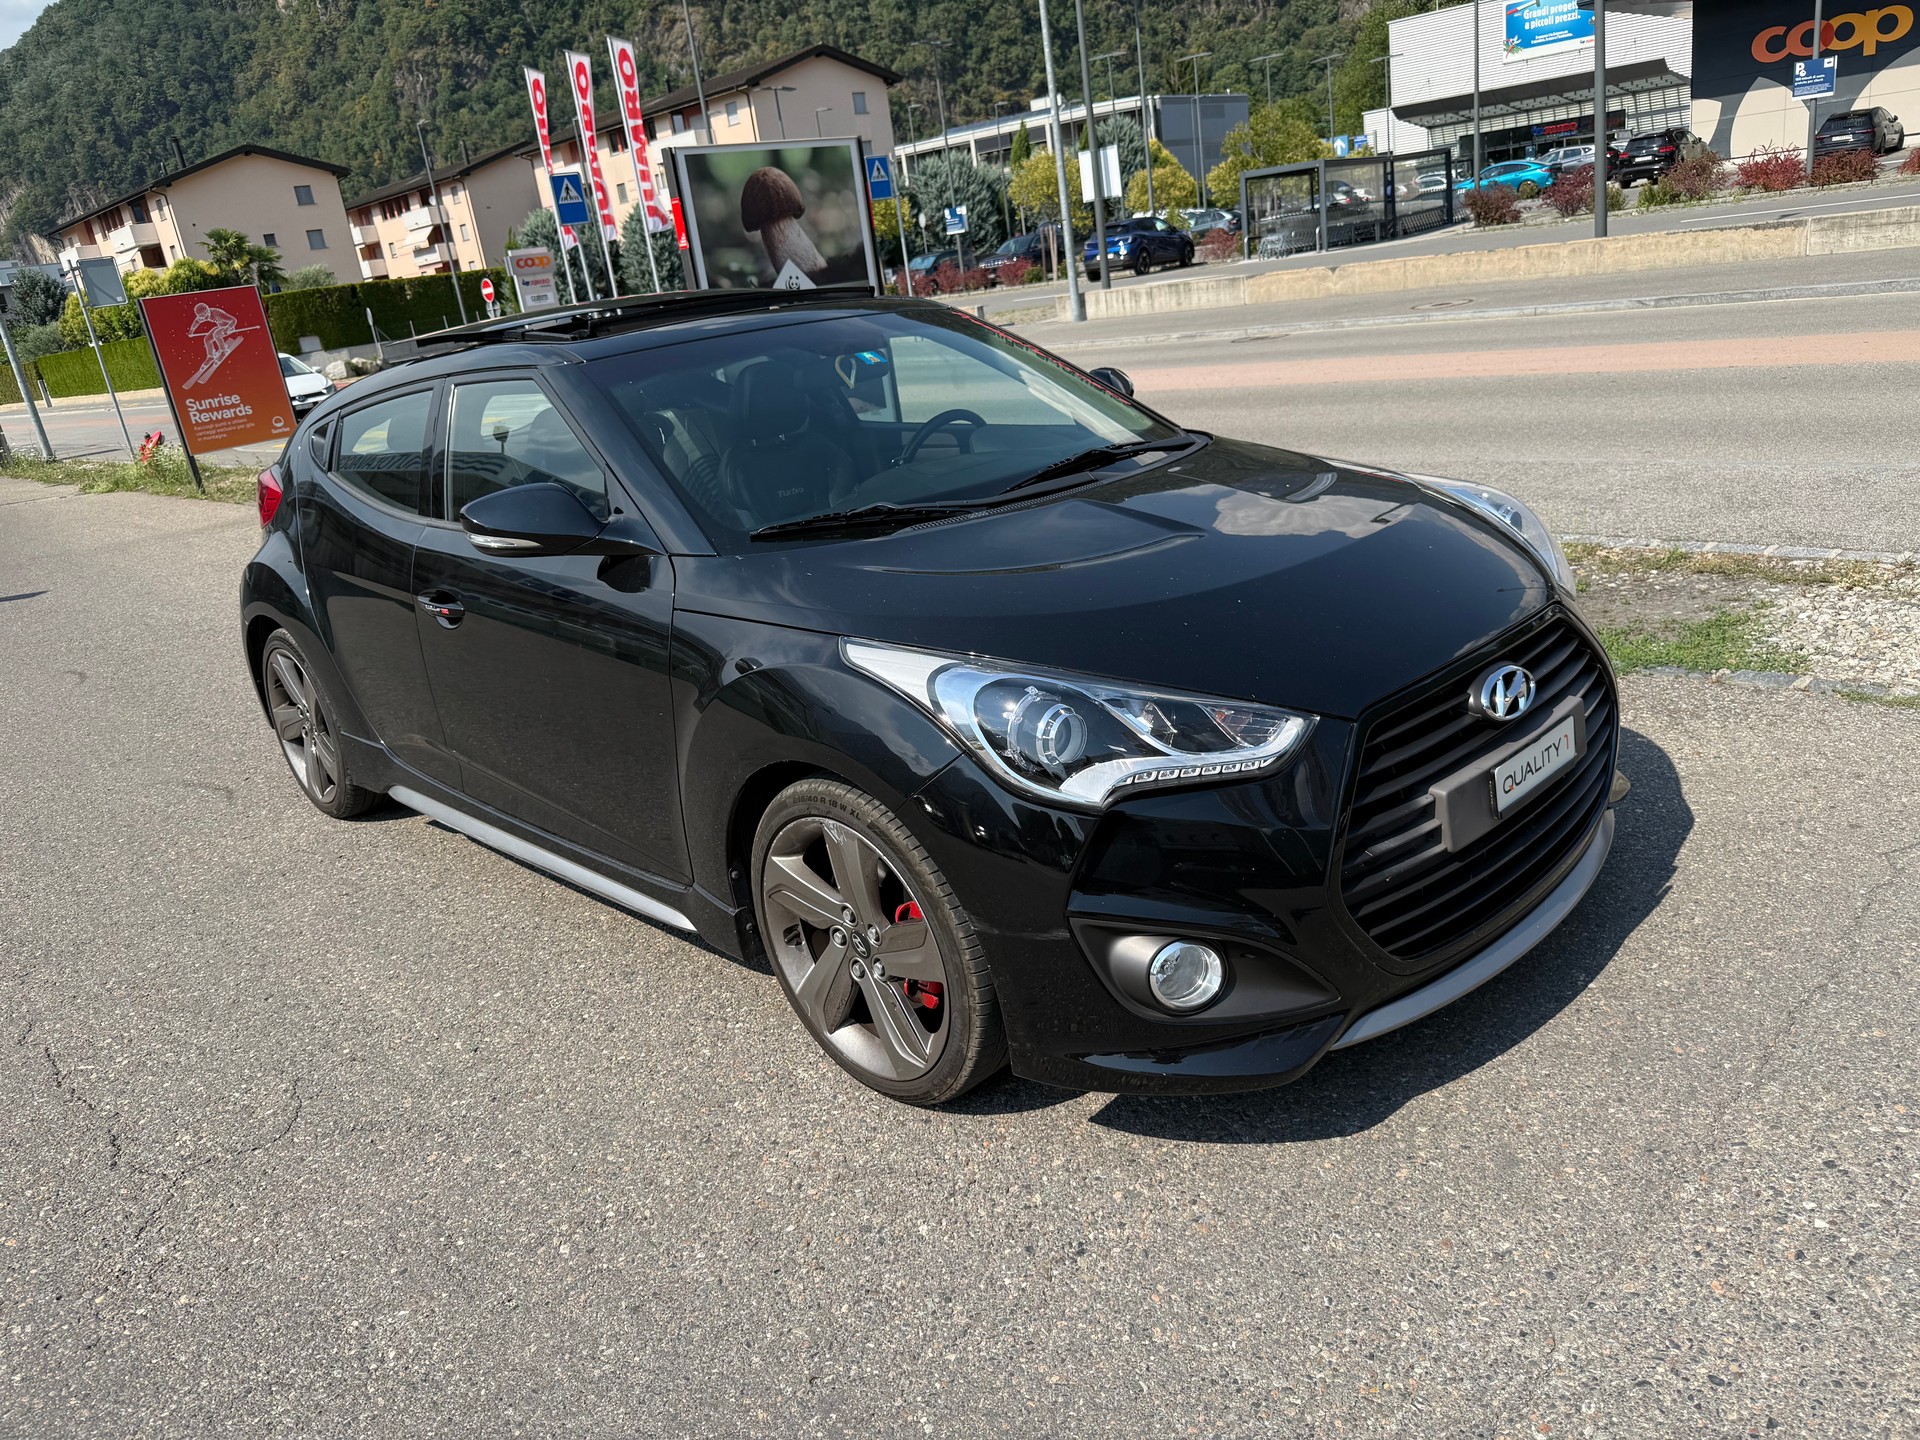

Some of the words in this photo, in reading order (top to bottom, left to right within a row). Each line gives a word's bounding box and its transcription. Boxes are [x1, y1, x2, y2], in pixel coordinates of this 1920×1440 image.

[1523, 5, 1549, 20] Grandi
[1550, 0, 1579, 15] progett
[1524, 21, 1530, 30] a
[1530, 15, 1554, 30] piccoli
[1555, 10, 1581, 25] prezzi.
[1751, 5, 1914, 63] coop
[575, 61, 618, 234] JUMBO
[618, 48, 669, 226] JUMBO
[532, 78, 578, 244] JMBO
[515, 255, 552, 270] coop
[186, 393, 241, 412] Sunrise
[189, 404, 253, 425] Rewards
[777, 488, 804, 498] Turbo
[820, 797, 826, 805] R
[829, 799, 838, 808] 18
[840, 803, 848, 812] W
[849, 808, 861, 821] XL
